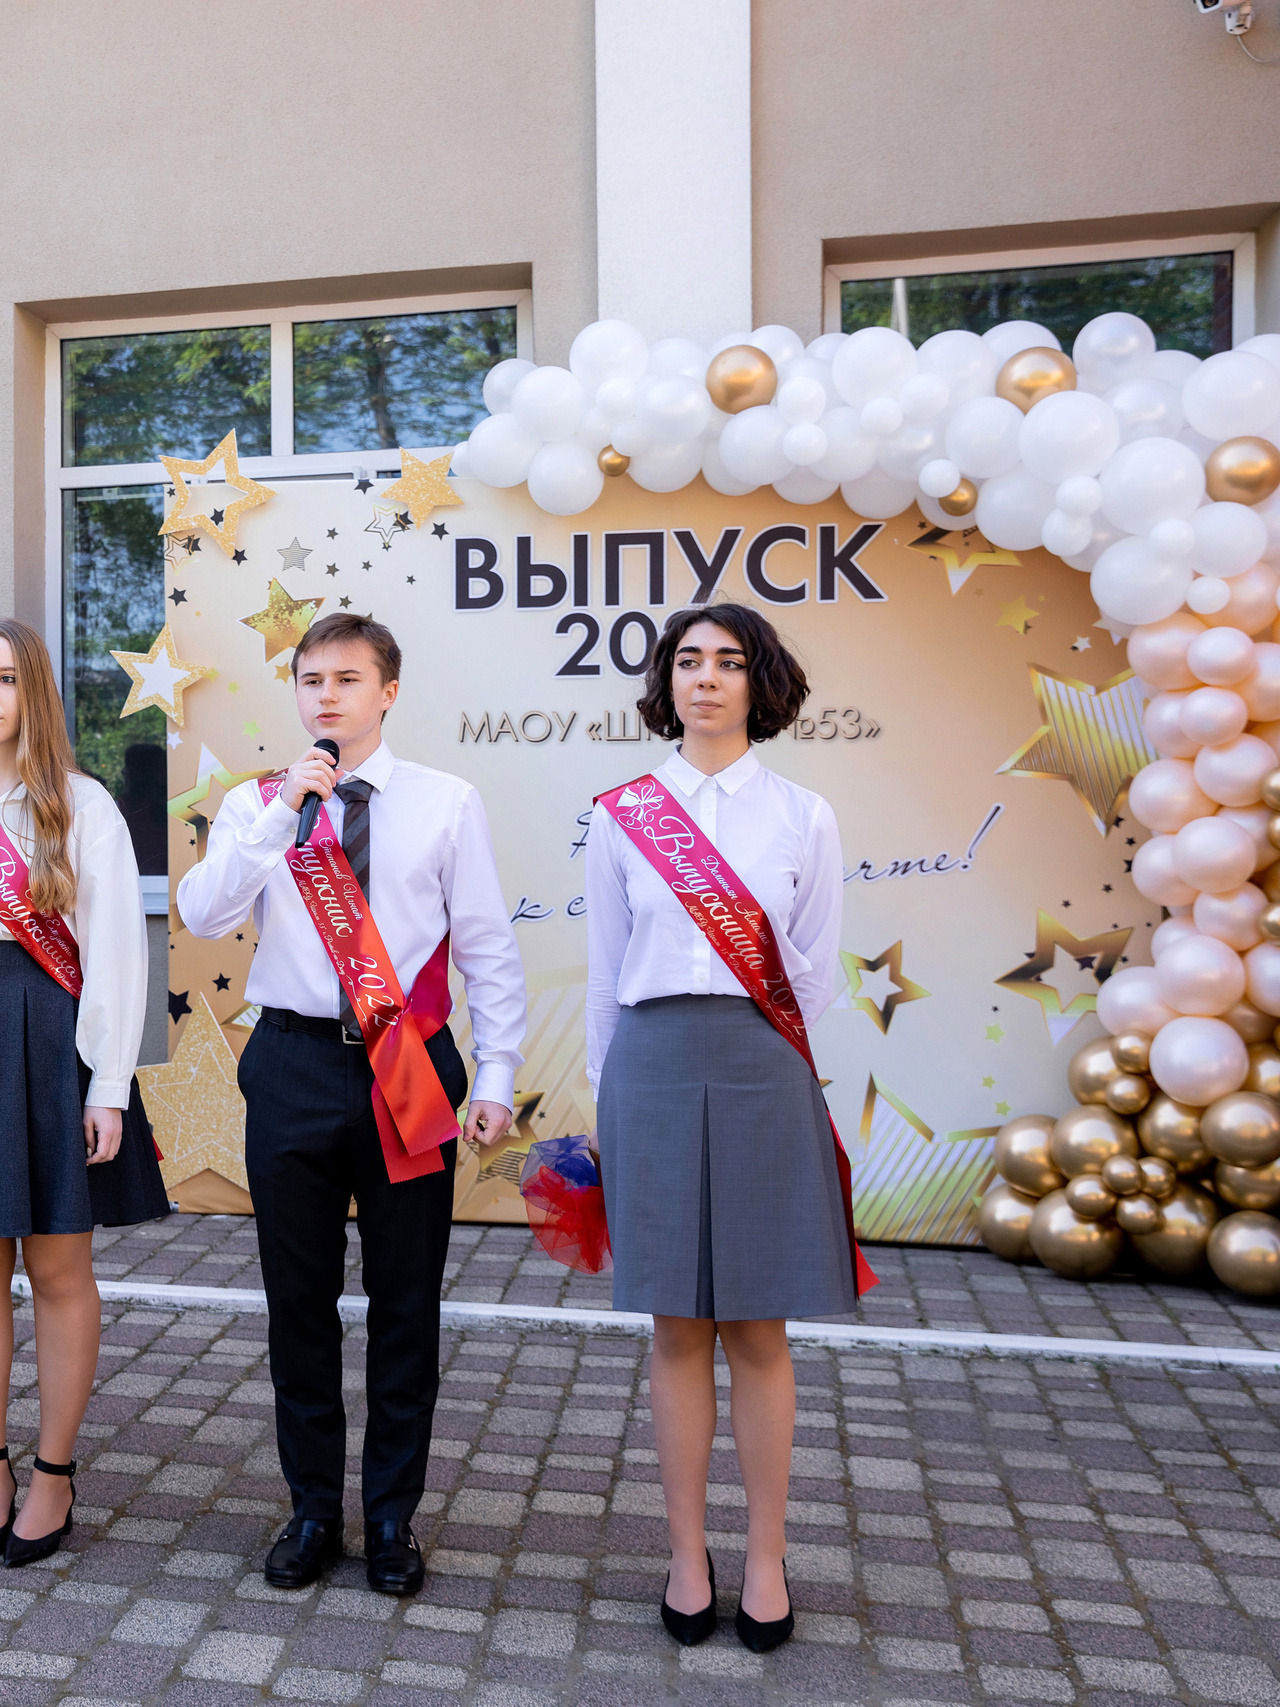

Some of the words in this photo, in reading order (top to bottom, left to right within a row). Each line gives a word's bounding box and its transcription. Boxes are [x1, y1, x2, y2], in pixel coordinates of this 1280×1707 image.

[454, 523, 884, 609] ВЫПУСК
[555, 609, 662, 676] 20
[458, 710, 577, 743] МАОУ
[289, 816, 352, 937] пускник
[643, 815, 763, 969] Выпускница
[758, 972, 808, 1035] 2022
